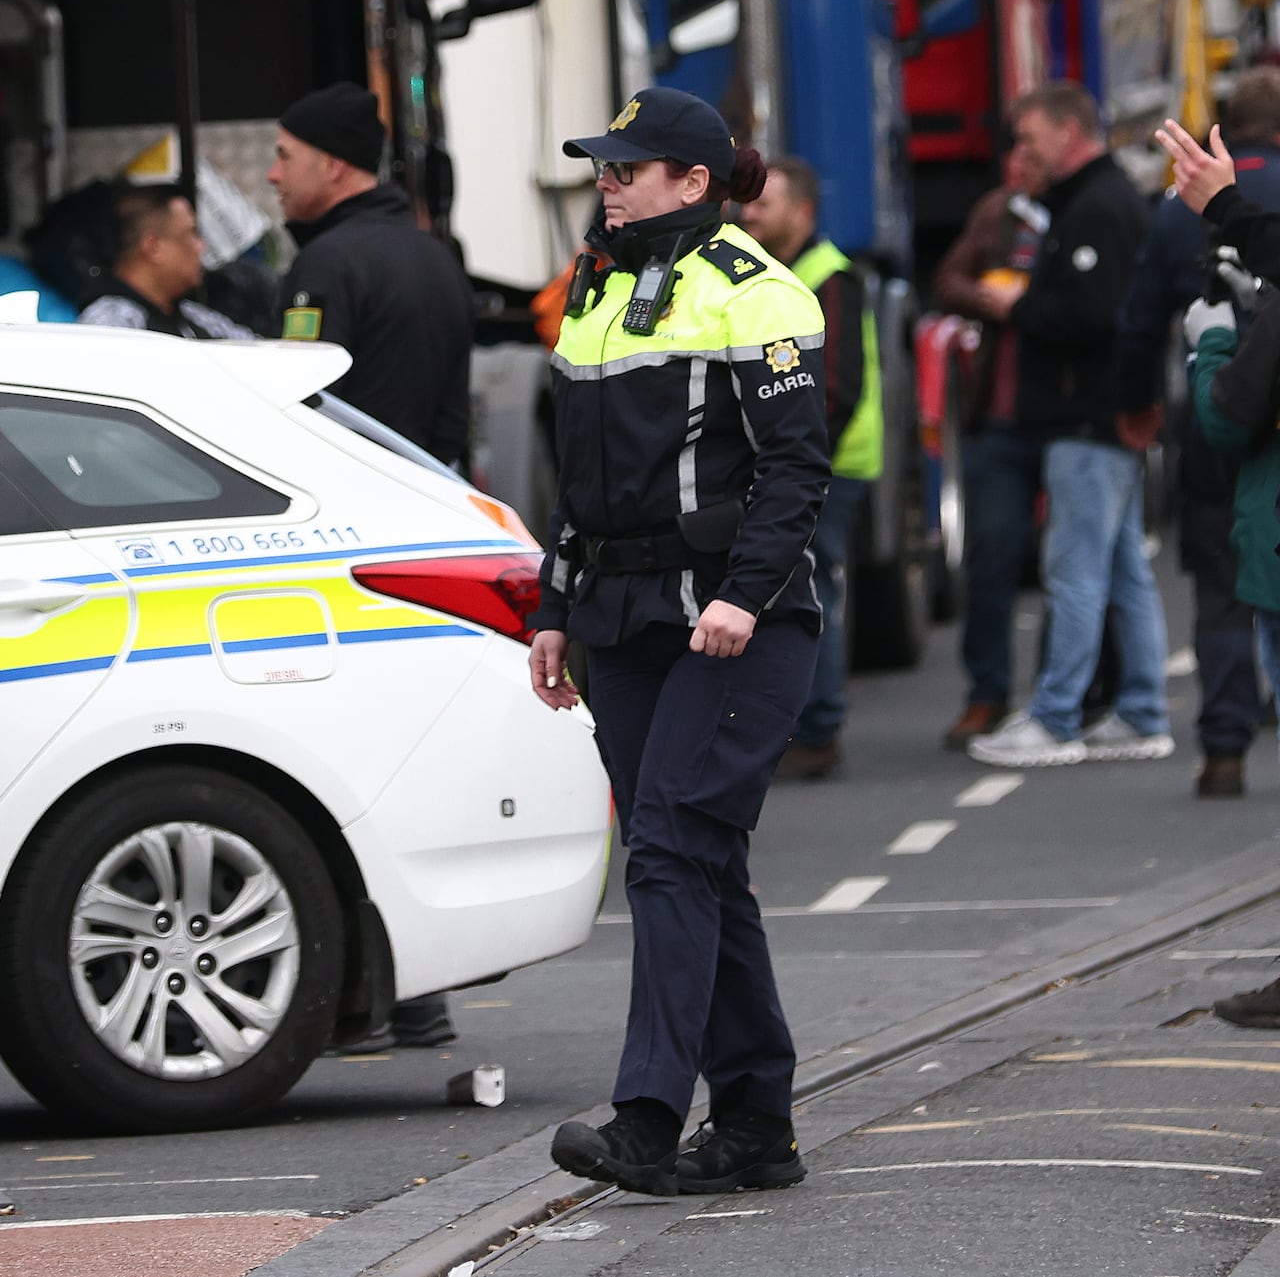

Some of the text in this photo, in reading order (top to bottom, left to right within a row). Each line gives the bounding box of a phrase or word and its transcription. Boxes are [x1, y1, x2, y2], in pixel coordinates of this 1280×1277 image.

[168, 526, 362, 556] 1 800 666 111
